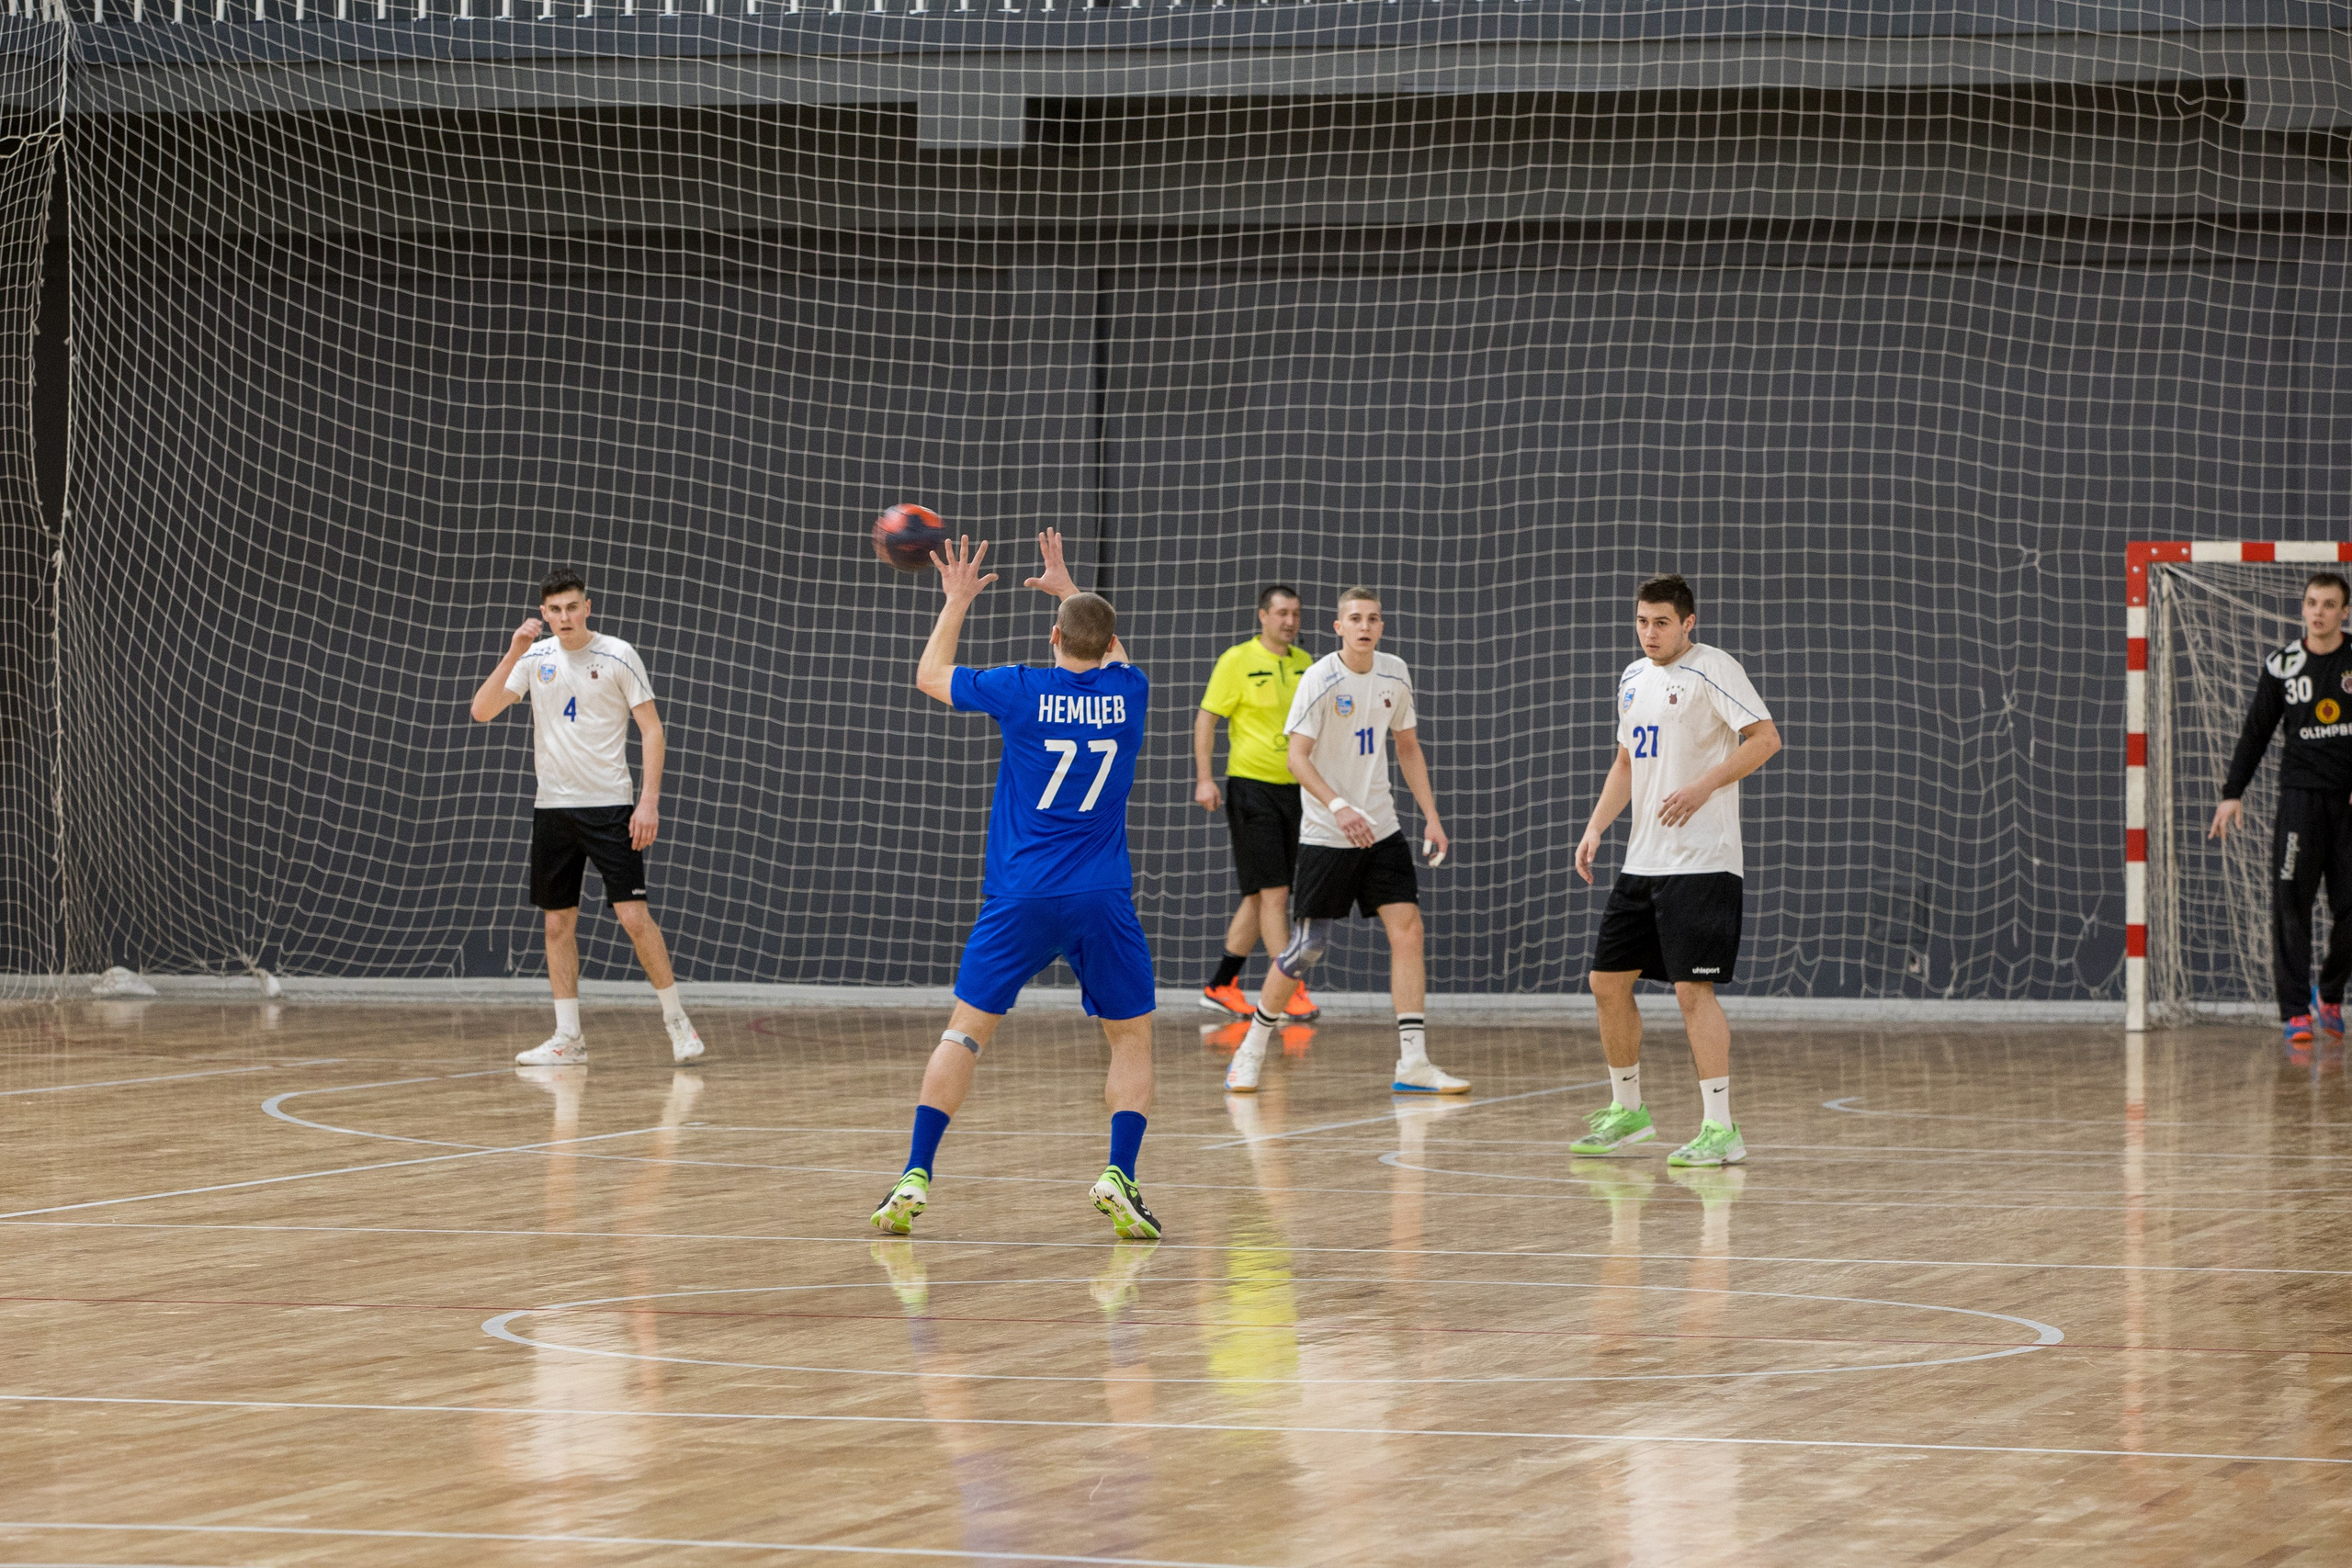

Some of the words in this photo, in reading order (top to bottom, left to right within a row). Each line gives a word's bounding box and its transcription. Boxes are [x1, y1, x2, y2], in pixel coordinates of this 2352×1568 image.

[2284, 675, 2312, 705] 30
[563, 695, 577, 722] 4
[1038, 694, 1126, 729] НЕМЦЕВ
[1355, 727, 1374, 755] 11
[1633, 726, 1659, 758] 27
[1035, 739, 1118, 812] 77
[2280, 831, 2301, 880] Kempa
[1691, 966, 1720, 975] uhlsport
